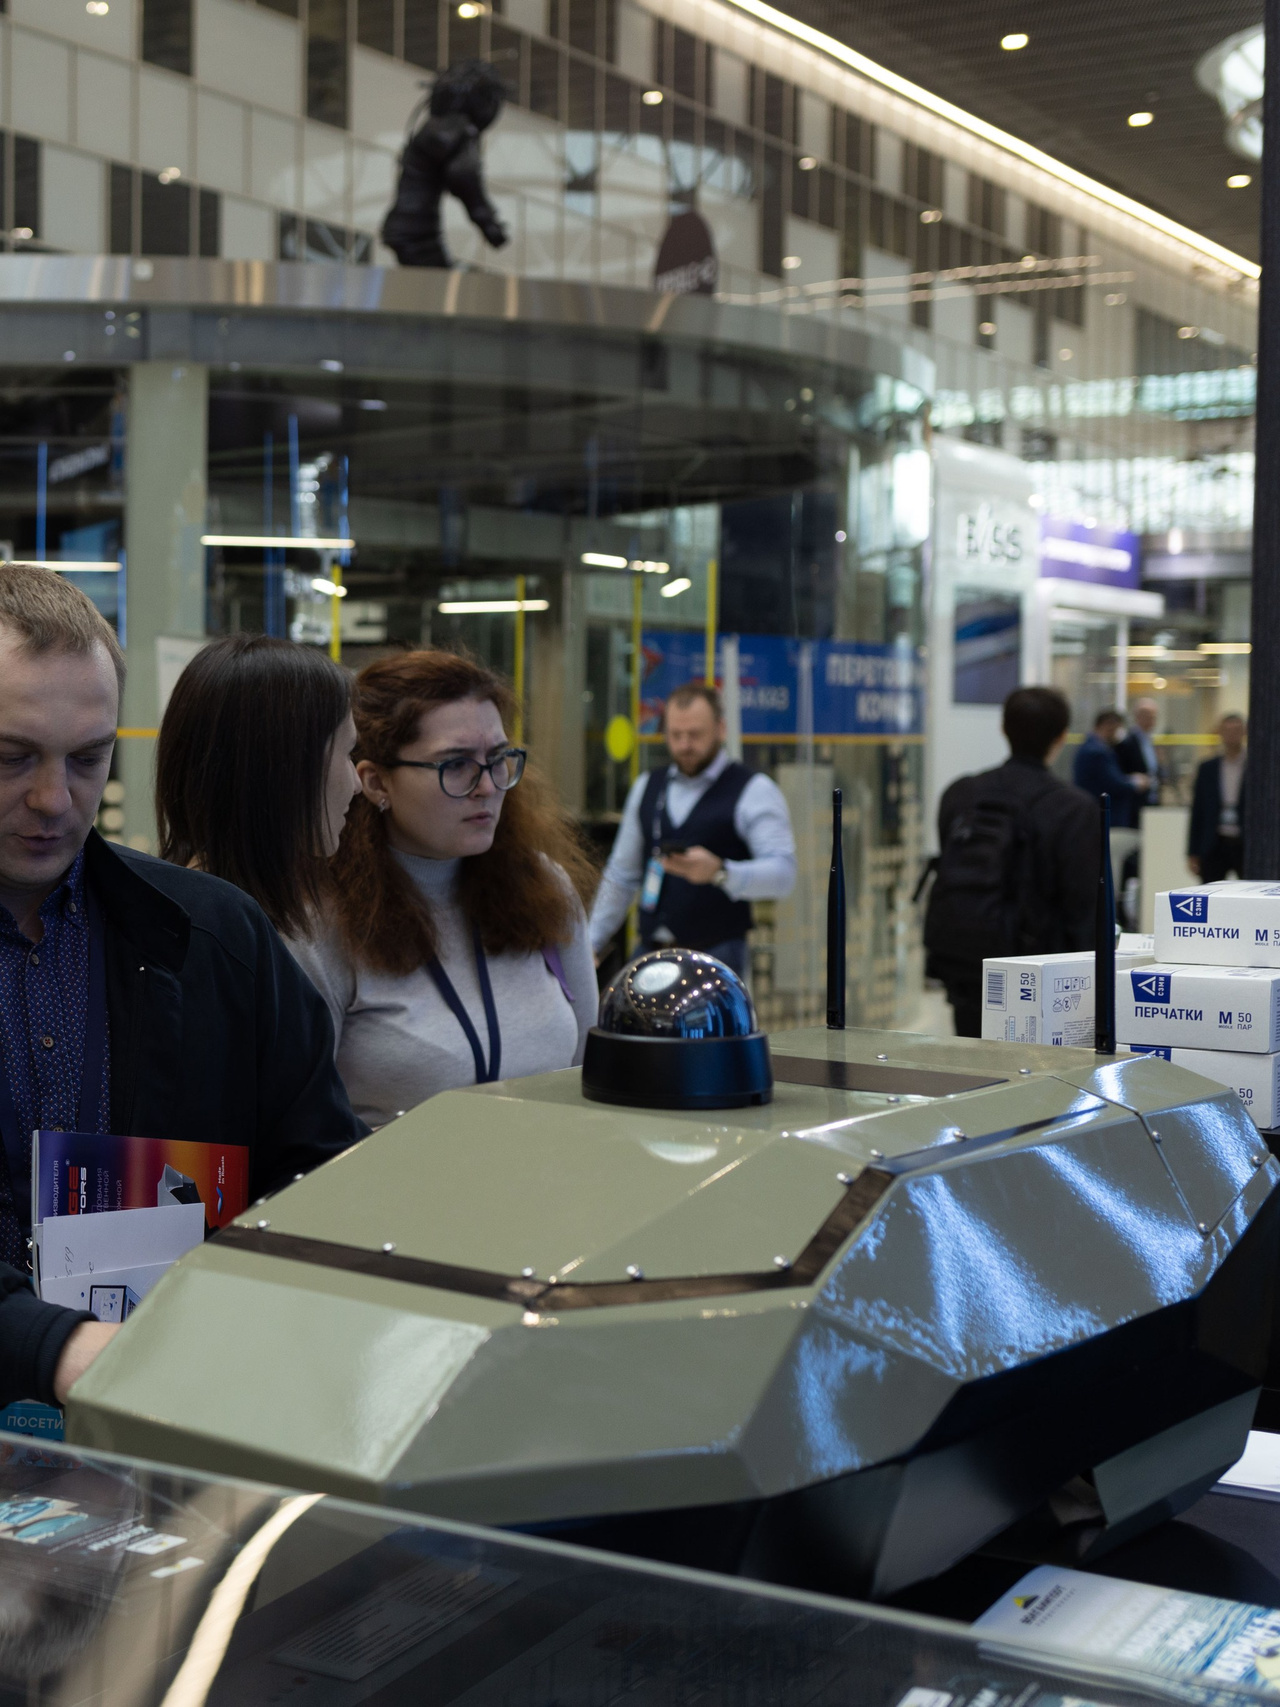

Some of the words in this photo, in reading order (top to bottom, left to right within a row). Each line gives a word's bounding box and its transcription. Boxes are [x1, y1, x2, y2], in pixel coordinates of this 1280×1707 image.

[1173, 926, 1240, 940] ПЕРЧАТКИ
[1020, 972, 1030, 985] 50
[1134, 1006, 1203, 1021] ПЕРЧАТКИ
[1238, 1012, 1252, 1023] 50
[1239, 1088, 1253, 1099] 50
